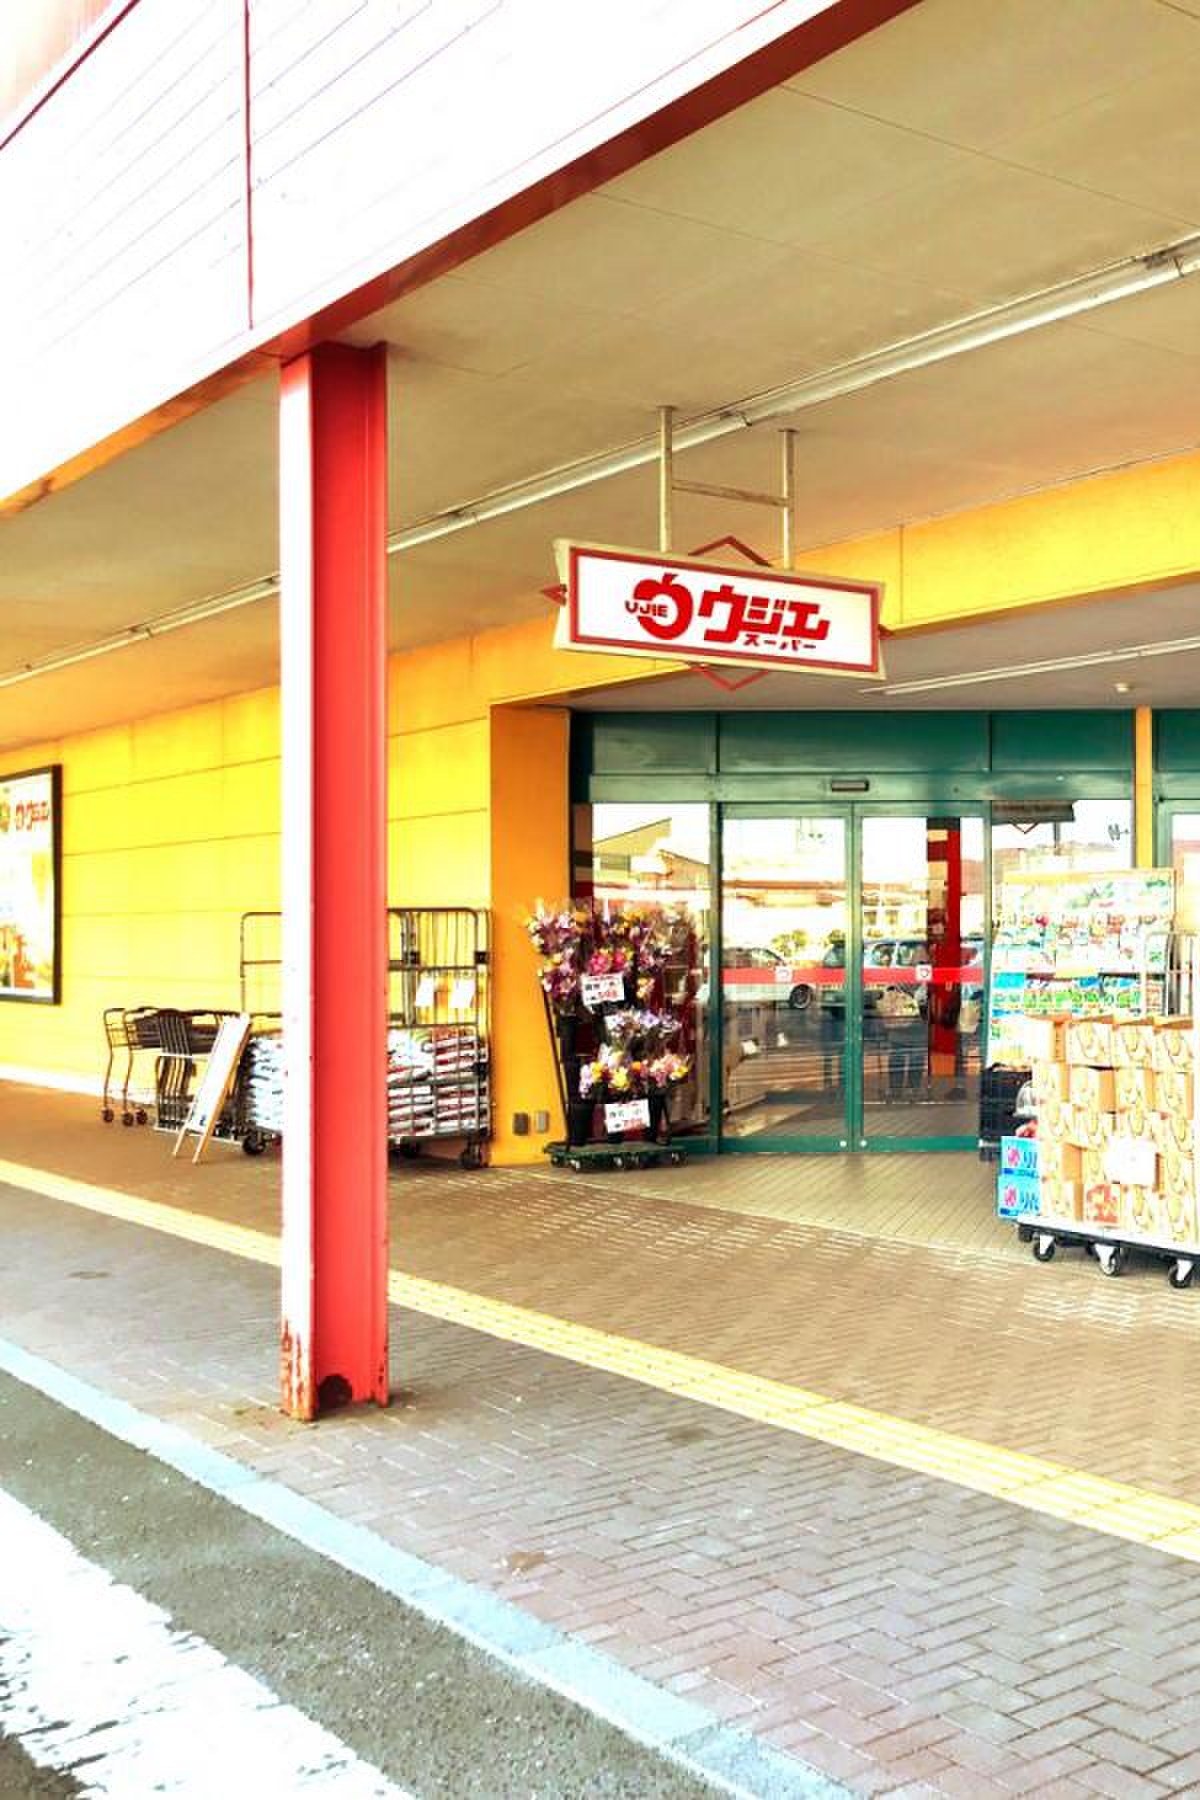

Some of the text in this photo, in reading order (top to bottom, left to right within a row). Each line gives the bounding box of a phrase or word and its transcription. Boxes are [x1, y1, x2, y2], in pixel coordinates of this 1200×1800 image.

[625, 599, 668, 618] UJIE
[698, 585, 830, 643] ウジエ
[743, 633, 816, 651] スーパー
